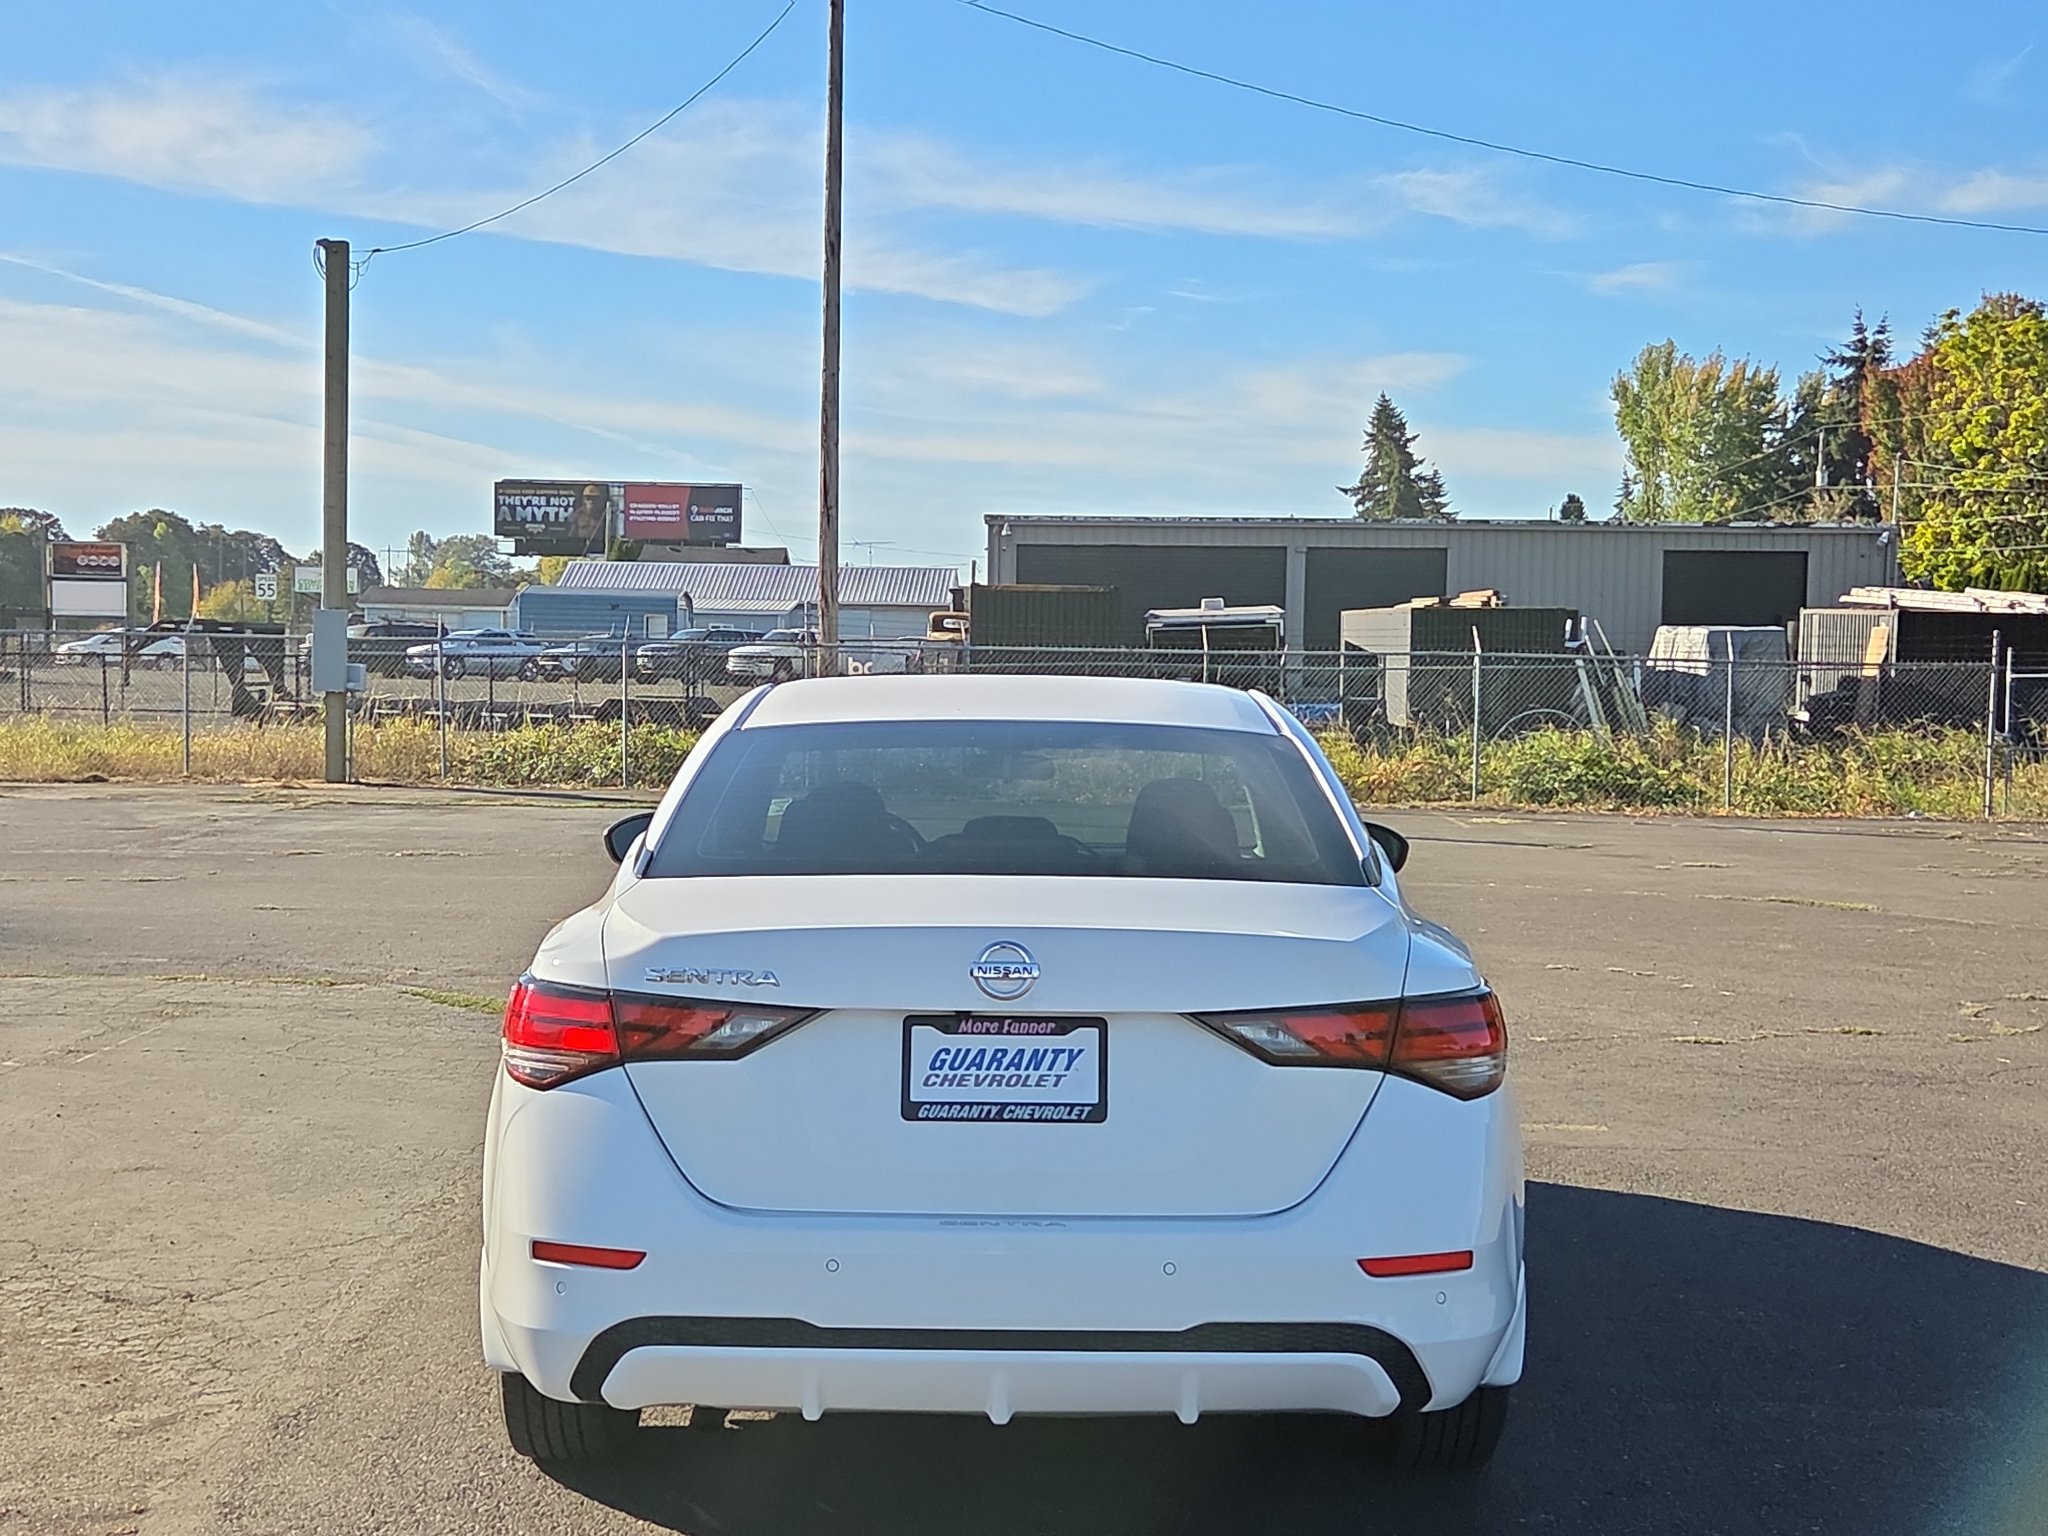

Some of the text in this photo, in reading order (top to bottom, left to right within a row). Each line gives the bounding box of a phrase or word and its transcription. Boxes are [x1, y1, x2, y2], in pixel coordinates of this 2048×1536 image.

[498, 496, 576, 506] THEY'RE NOT
[497, 506, 574, 522] A MYTH
[258, 584, 275, 597] 55
[645, 967, 780, 987] SENTRA
[977, 965, 1033, 975] NISSAN
[958, 1018, 1056, 1035] More Funner
[929, 1047, 1085, 1072] GUARANTY
[922, 1073, 1068, 1088] CHEVROLET
[918, 1104, 1092, 1121] GUARANTY CHEVROLET
